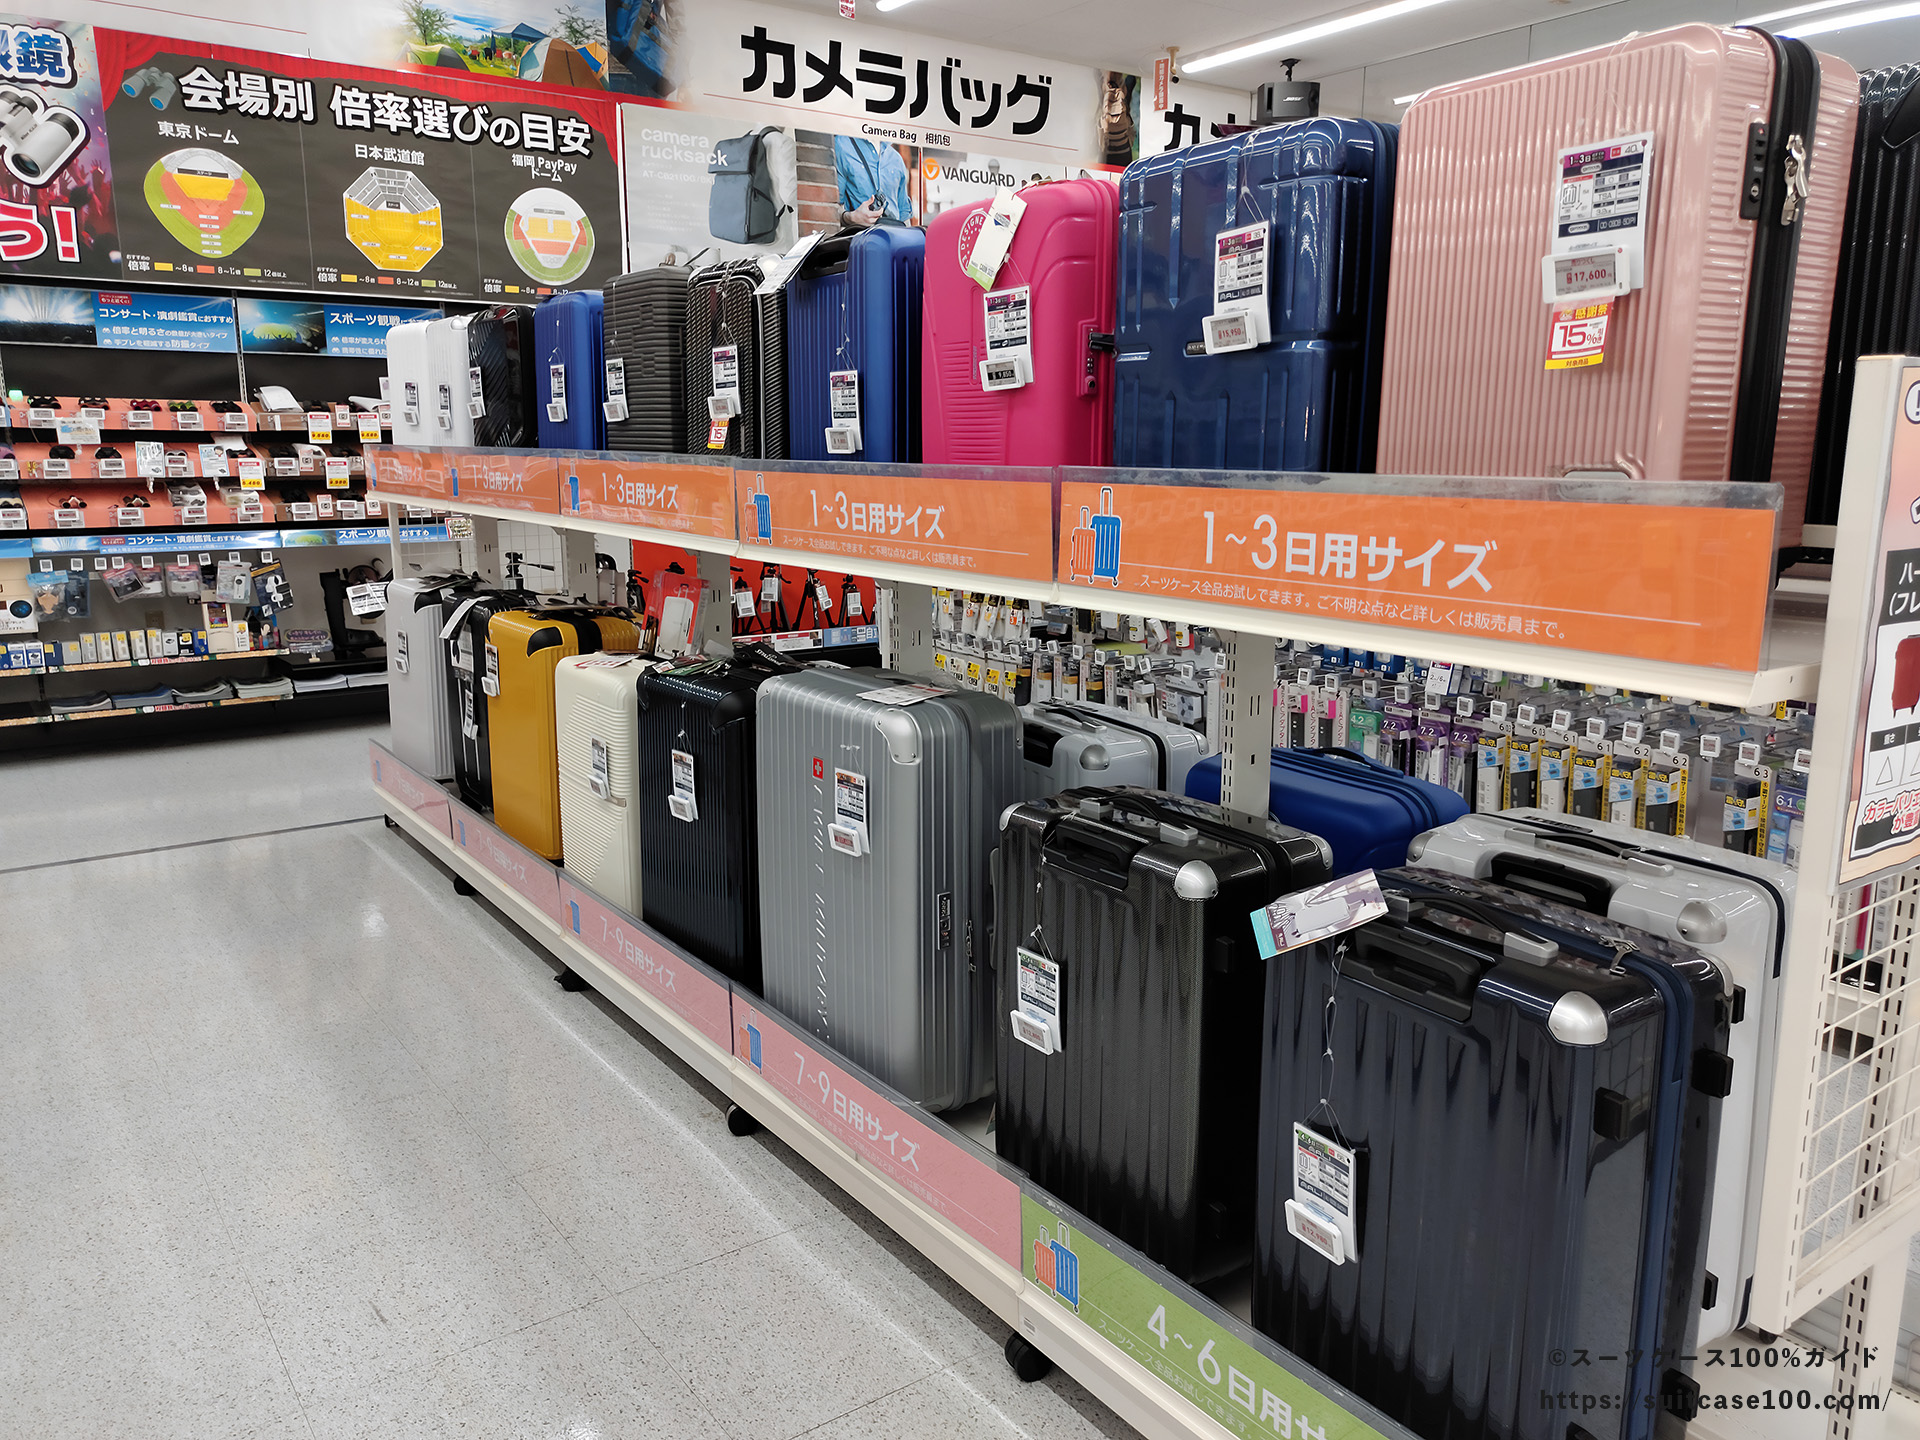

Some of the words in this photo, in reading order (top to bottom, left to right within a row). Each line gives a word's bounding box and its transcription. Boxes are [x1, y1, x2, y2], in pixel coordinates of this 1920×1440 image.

[741, 26, 1052, 135] カメラバッグ
[178, 66, 314, 122] 会場別
[330, 86, 592, 156] 倍率選びの目安
[157, 121, 240, 145] 東京ドーム
[641, 128, 709, 149] camera
[862, 123, 896, 139] Camera
[899, 128, 917, 143] Bag
[355, 144, 425, 166] 日本武道館
[512, 154, 535, 168] 福岡
[538, 156, 577, 173] PayPay
[641, 144, 729, 166] rucksack
[531, 167, 563, 182] ドーム
[942, 165, 1015, 187] VANGUARD
[1574, 269, 1606, 283] 17,600
[99, 308, 233, 324] コンサート・演劇鑑賞におすすめ
[1575, 304, 1608, 319] 感謝祭
[601, 472, 679, 509] 1~3日用サイズ
[810, 489, 945, 540] 1~3日用サイズ
[1198, 509, 1498, 592] 1~3日用サイズ
[600, 915, 677, 992] 7~9日用サイズ
[794, 1051, 921, 1172] 7~9日用サイズ
